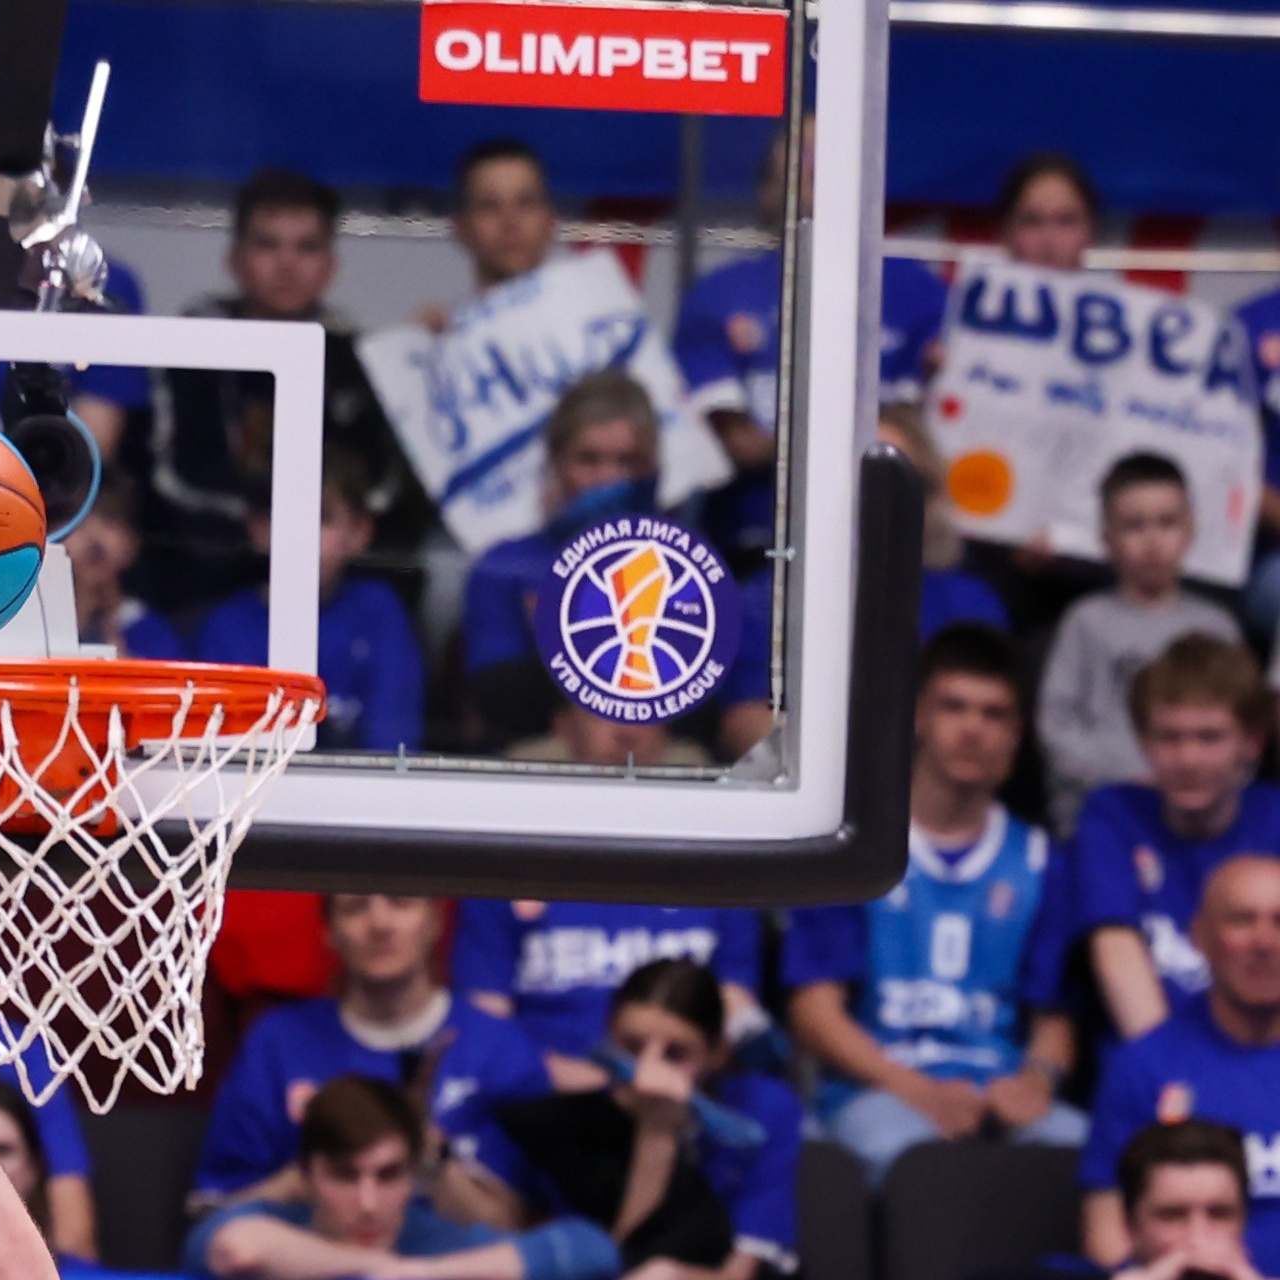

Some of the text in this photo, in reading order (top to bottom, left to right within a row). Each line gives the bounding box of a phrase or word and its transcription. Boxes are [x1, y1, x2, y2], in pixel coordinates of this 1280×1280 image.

[434, 28, 771, 84] OLIMPBET
[552, 518, 726, 585] ЕДИНАЯ ЛИГА ВТБ
[549, 651, 726, 722] VTB UNITED LEAGUE
